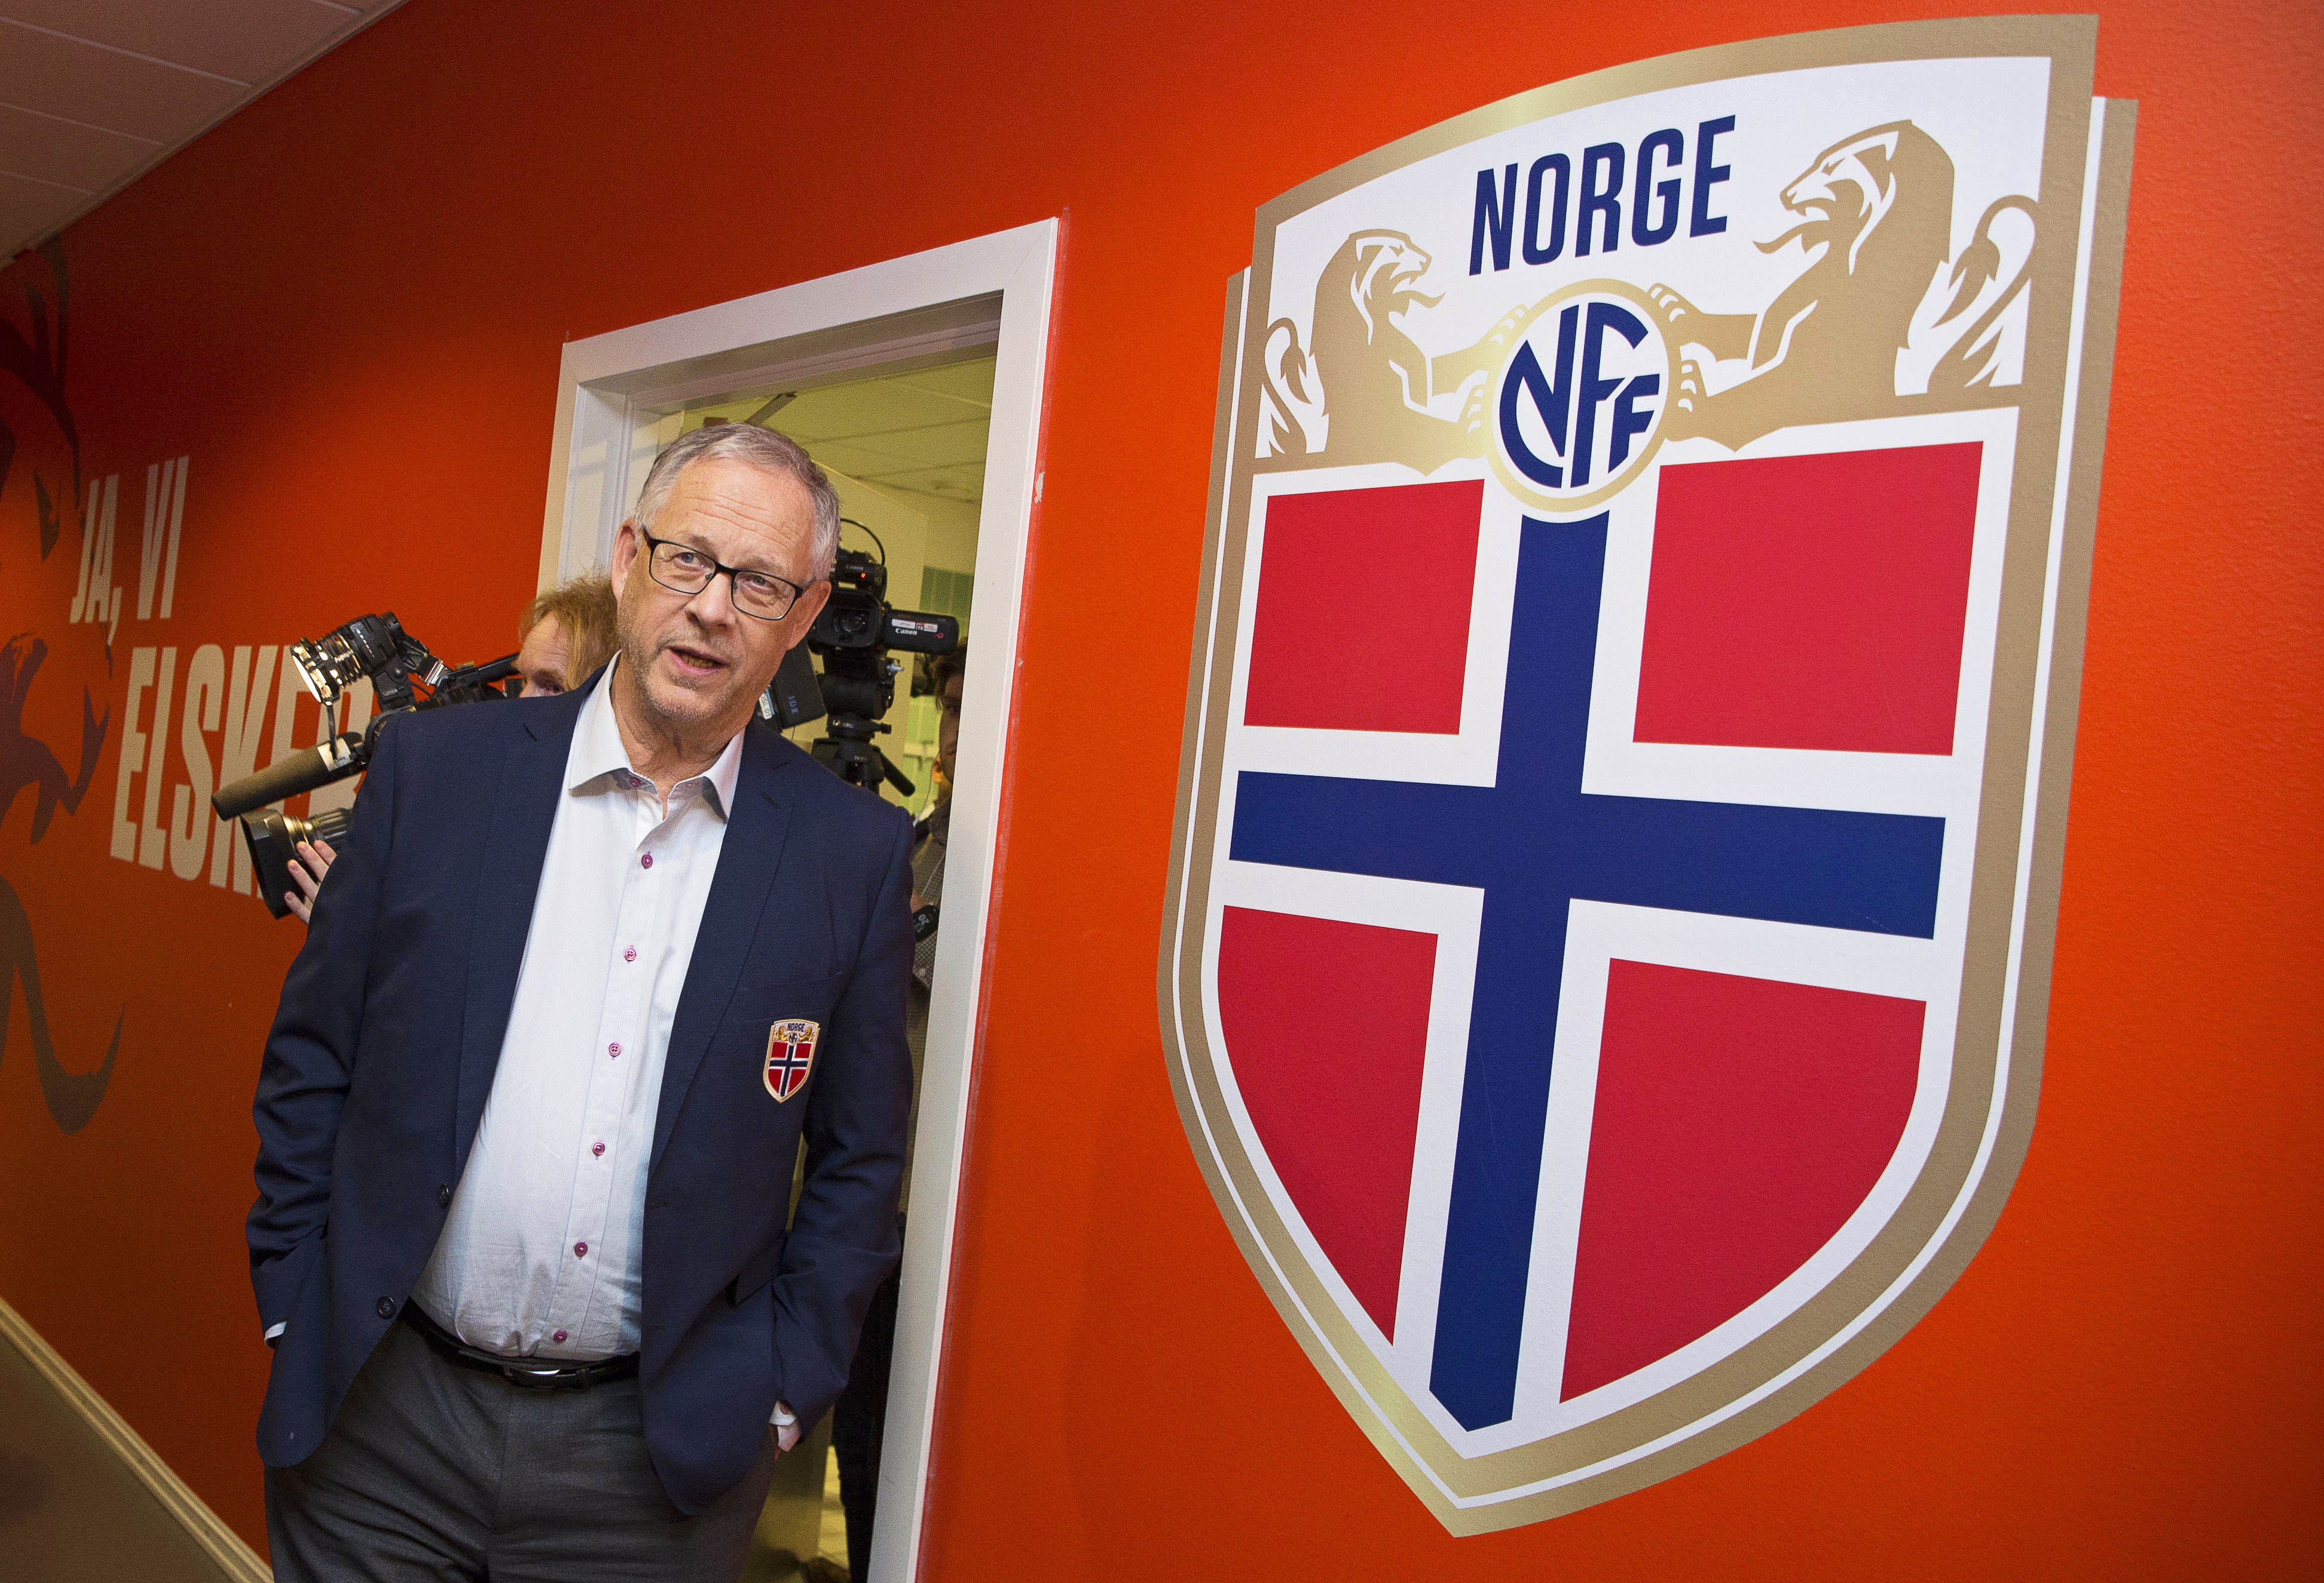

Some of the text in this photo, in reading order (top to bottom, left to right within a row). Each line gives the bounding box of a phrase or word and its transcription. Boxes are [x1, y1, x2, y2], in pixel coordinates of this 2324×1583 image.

[1469, 114, 1736, 276] NORGE
[1499, 302, 1660, 488] NFF
[69, 456, 189, 647] JA, VI
[895, 627, 918, 635] Canon
[787, 1023, 805, 1032] NORGE
